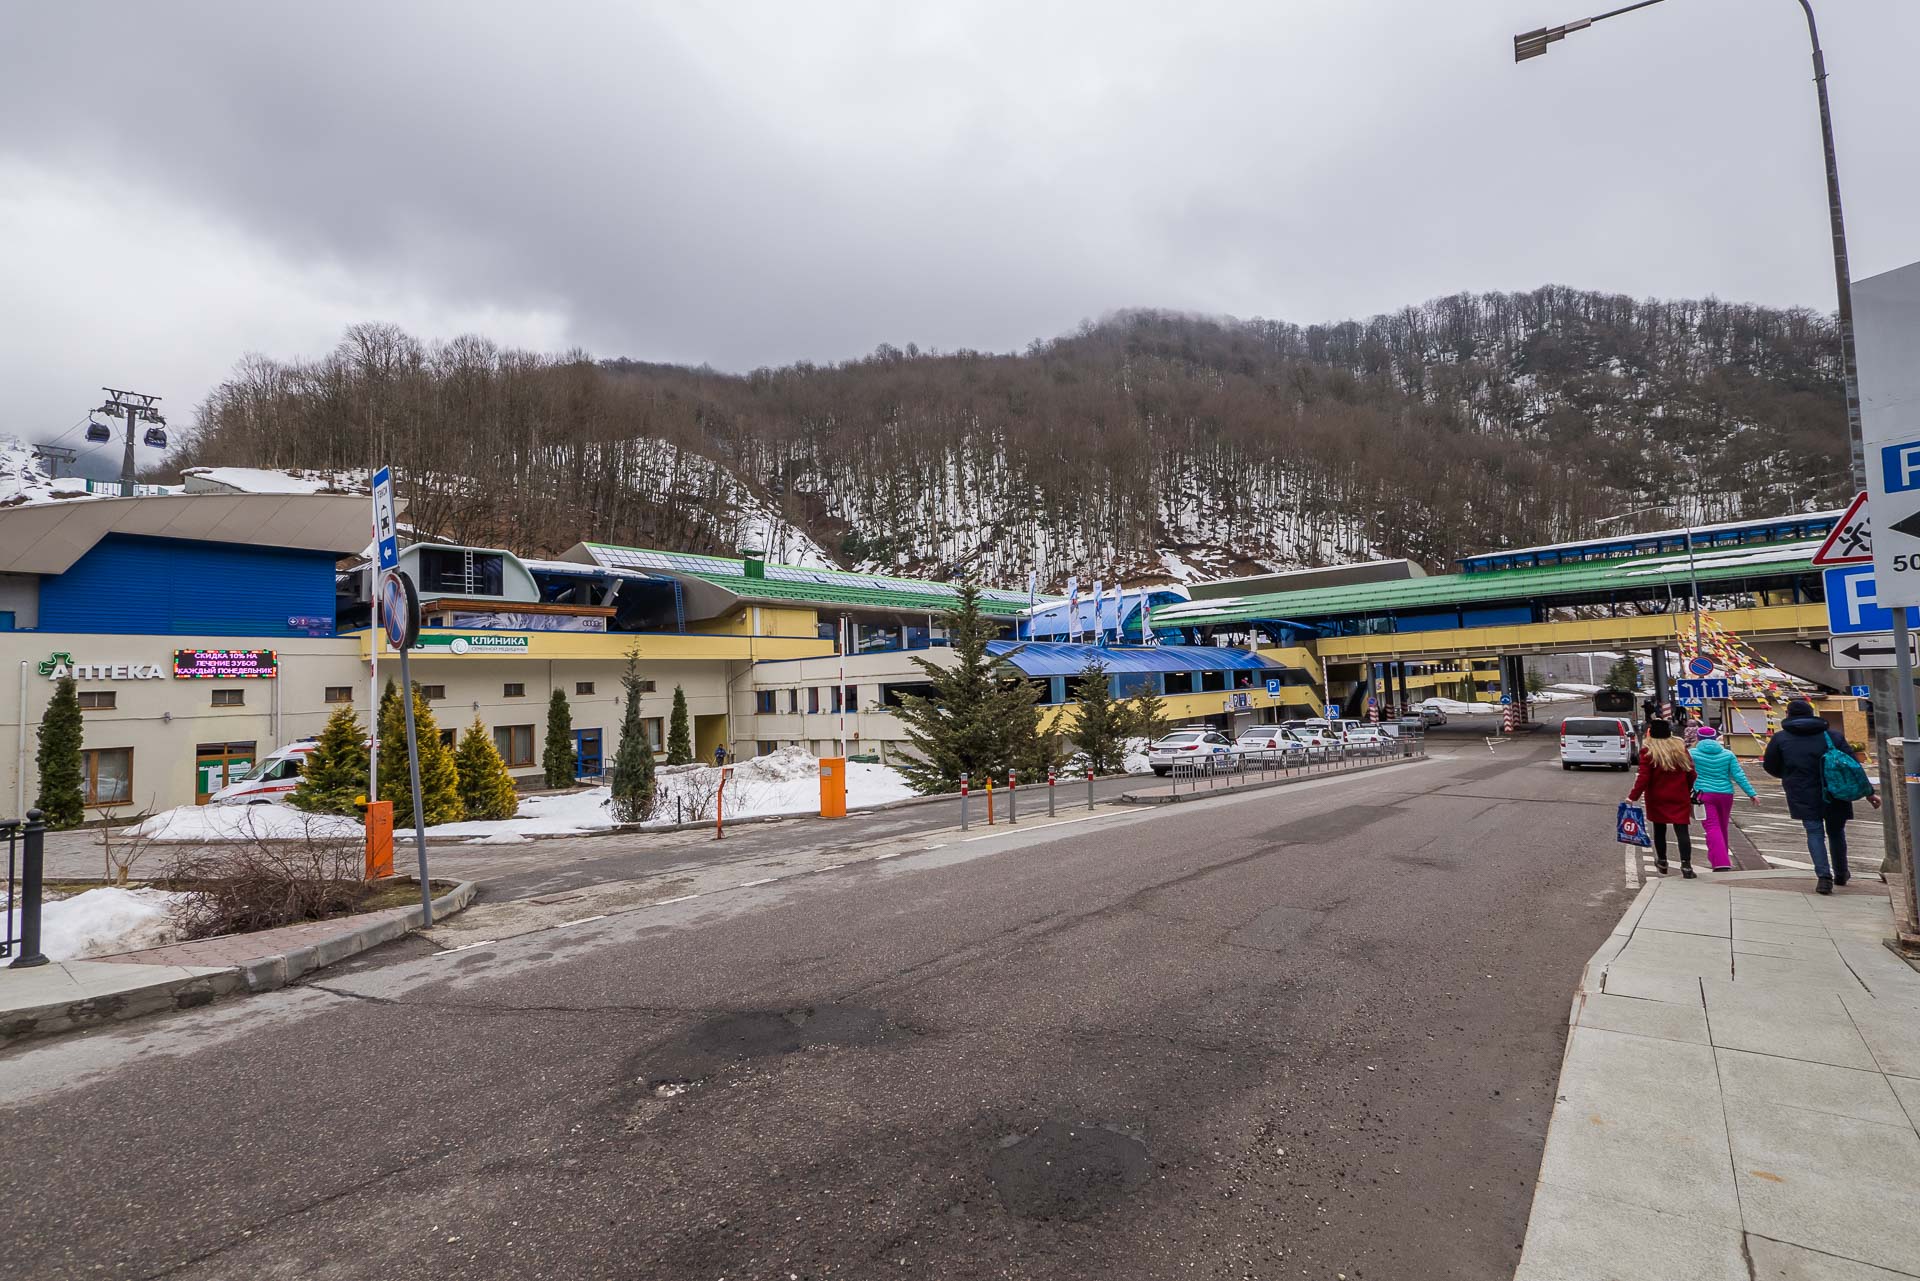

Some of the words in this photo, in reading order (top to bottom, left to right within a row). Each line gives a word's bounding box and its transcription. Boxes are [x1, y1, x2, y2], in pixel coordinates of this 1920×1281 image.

[471, 636, 526, 645] КЛИНИКА
[48, 664, 165, 680] АПТЕКА
[178, 666, 216, 674] КАЖДЫЙ
[1269, 681, 1276, 691] P
[1623, 821, 1636, 832] GJ
